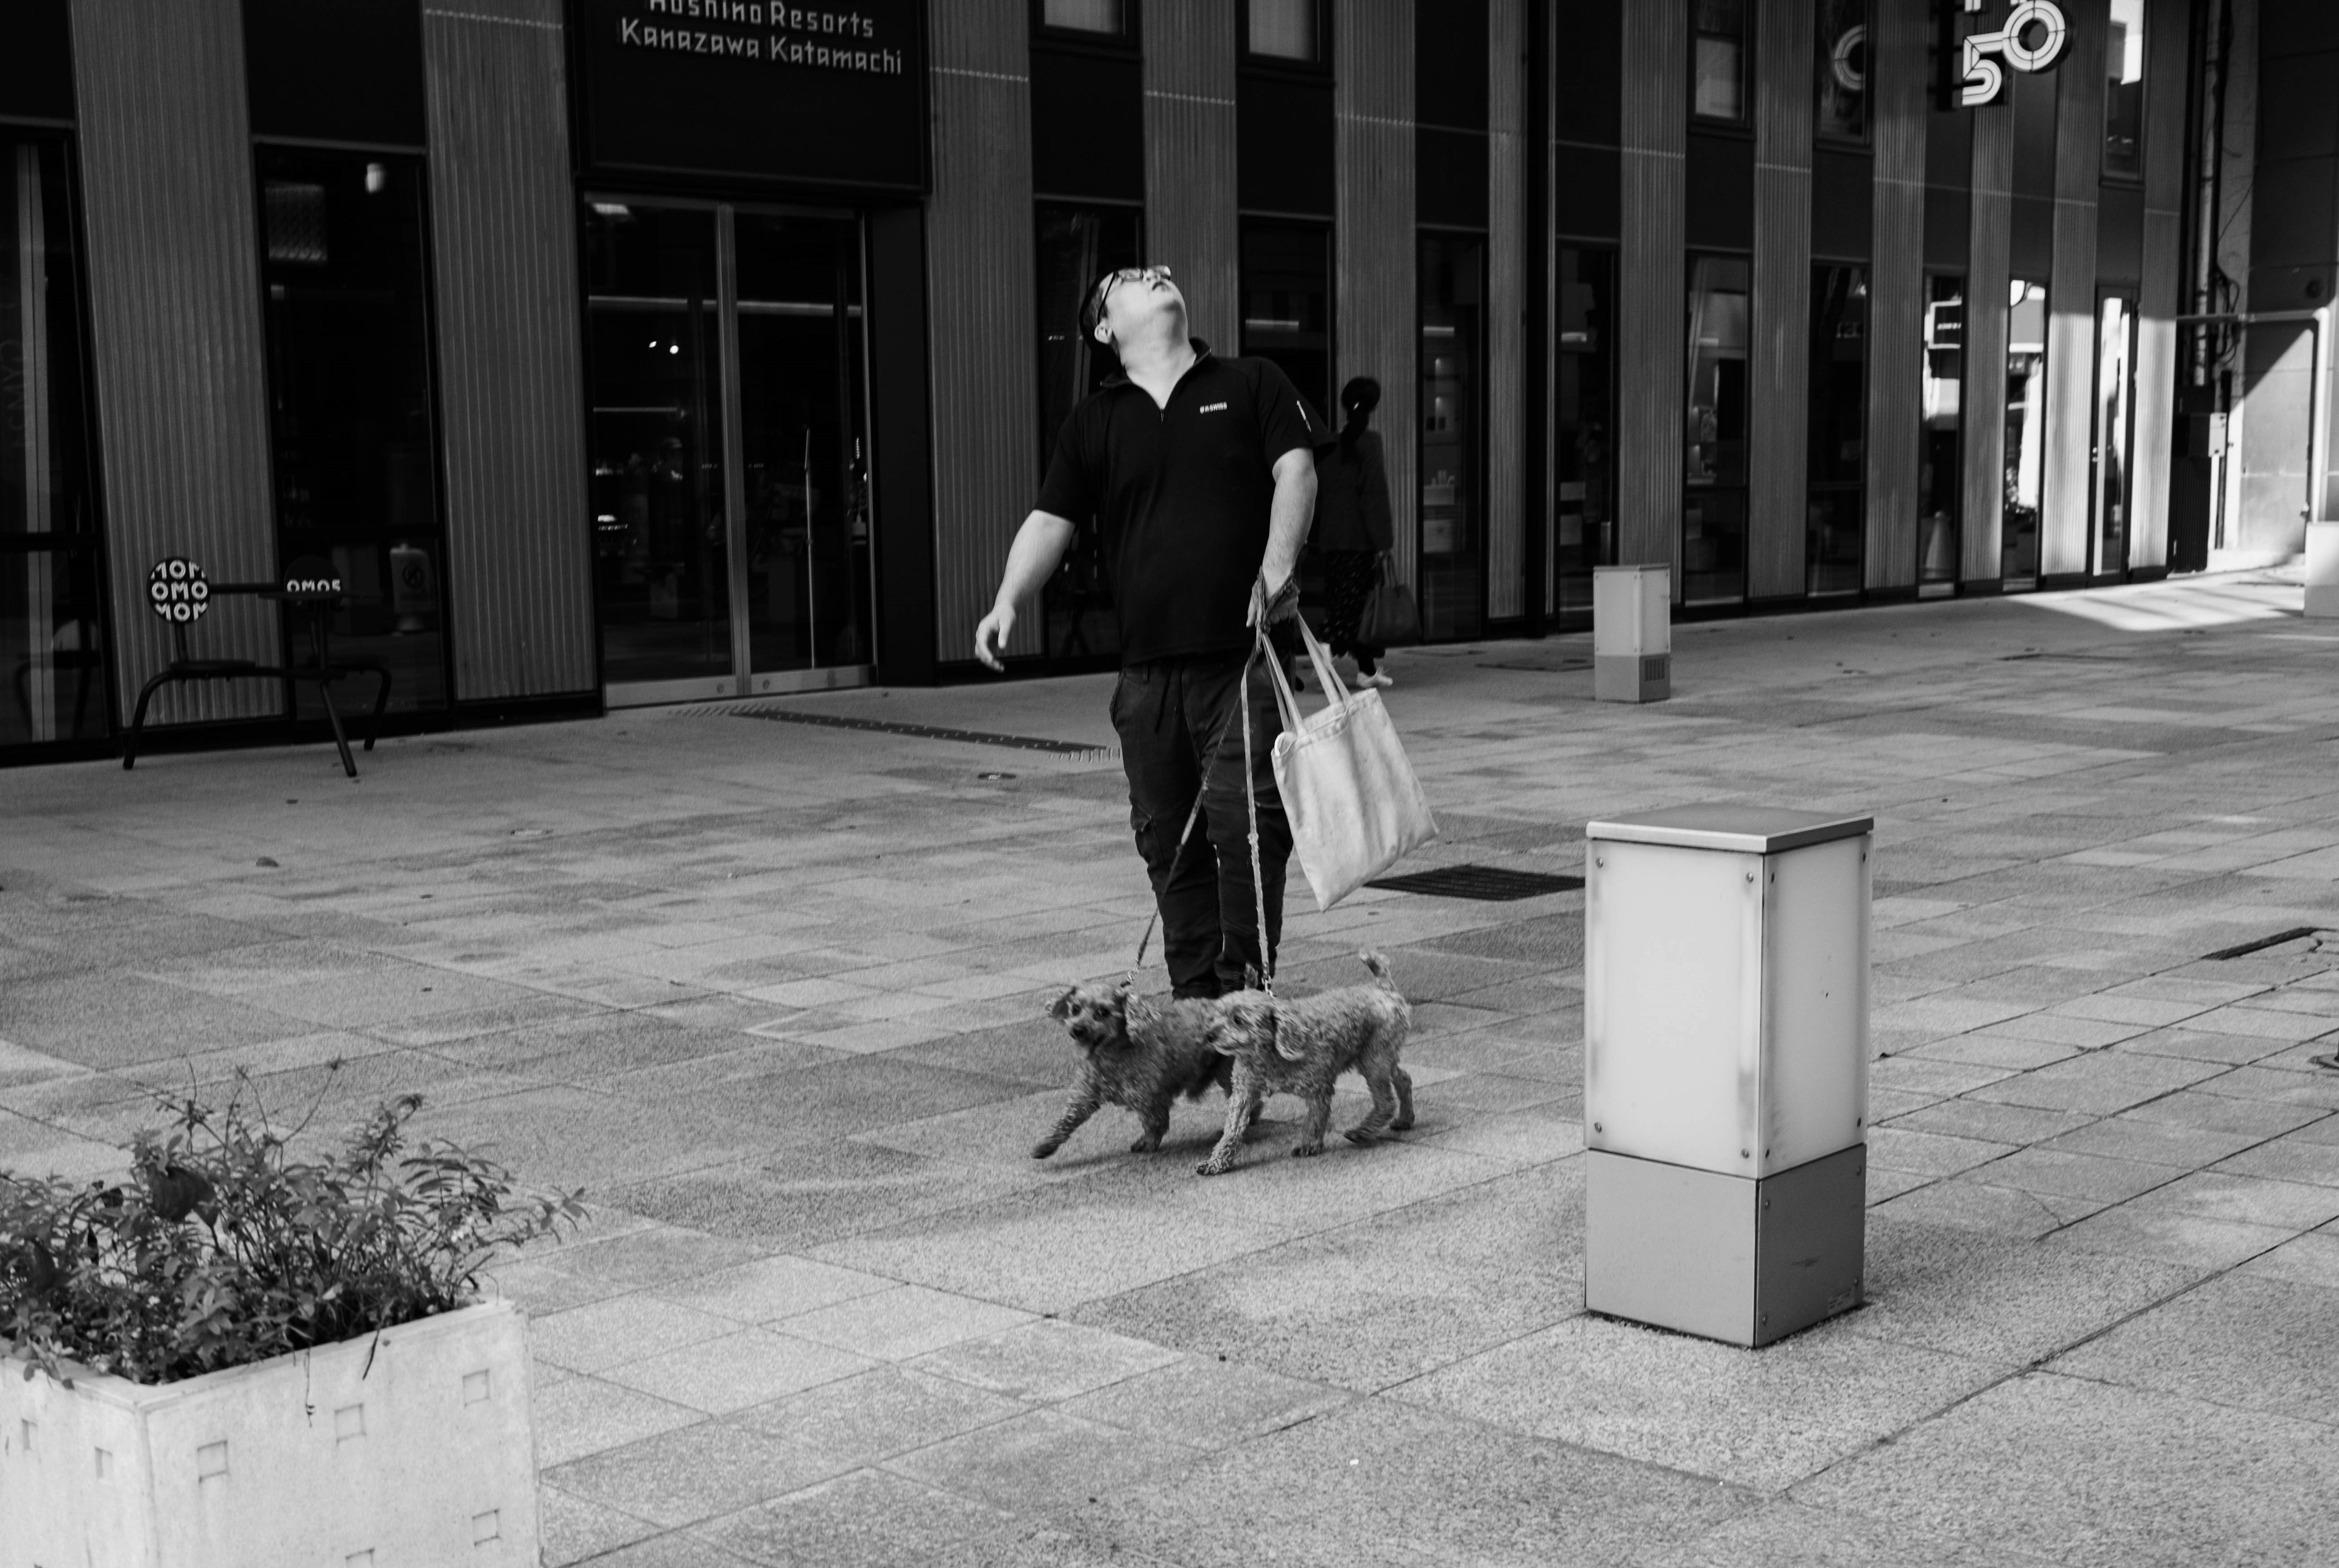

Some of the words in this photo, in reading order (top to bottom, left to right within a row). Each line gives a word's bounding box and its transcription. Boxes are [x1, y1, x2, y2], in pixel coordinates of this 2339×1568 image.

[771, 1, 873, 38] Resorts
[622, 16, 759, 58] Kanazawa
[771, 35, 901, 74] Katamachi
[151, 581, 208, 601] OMO
